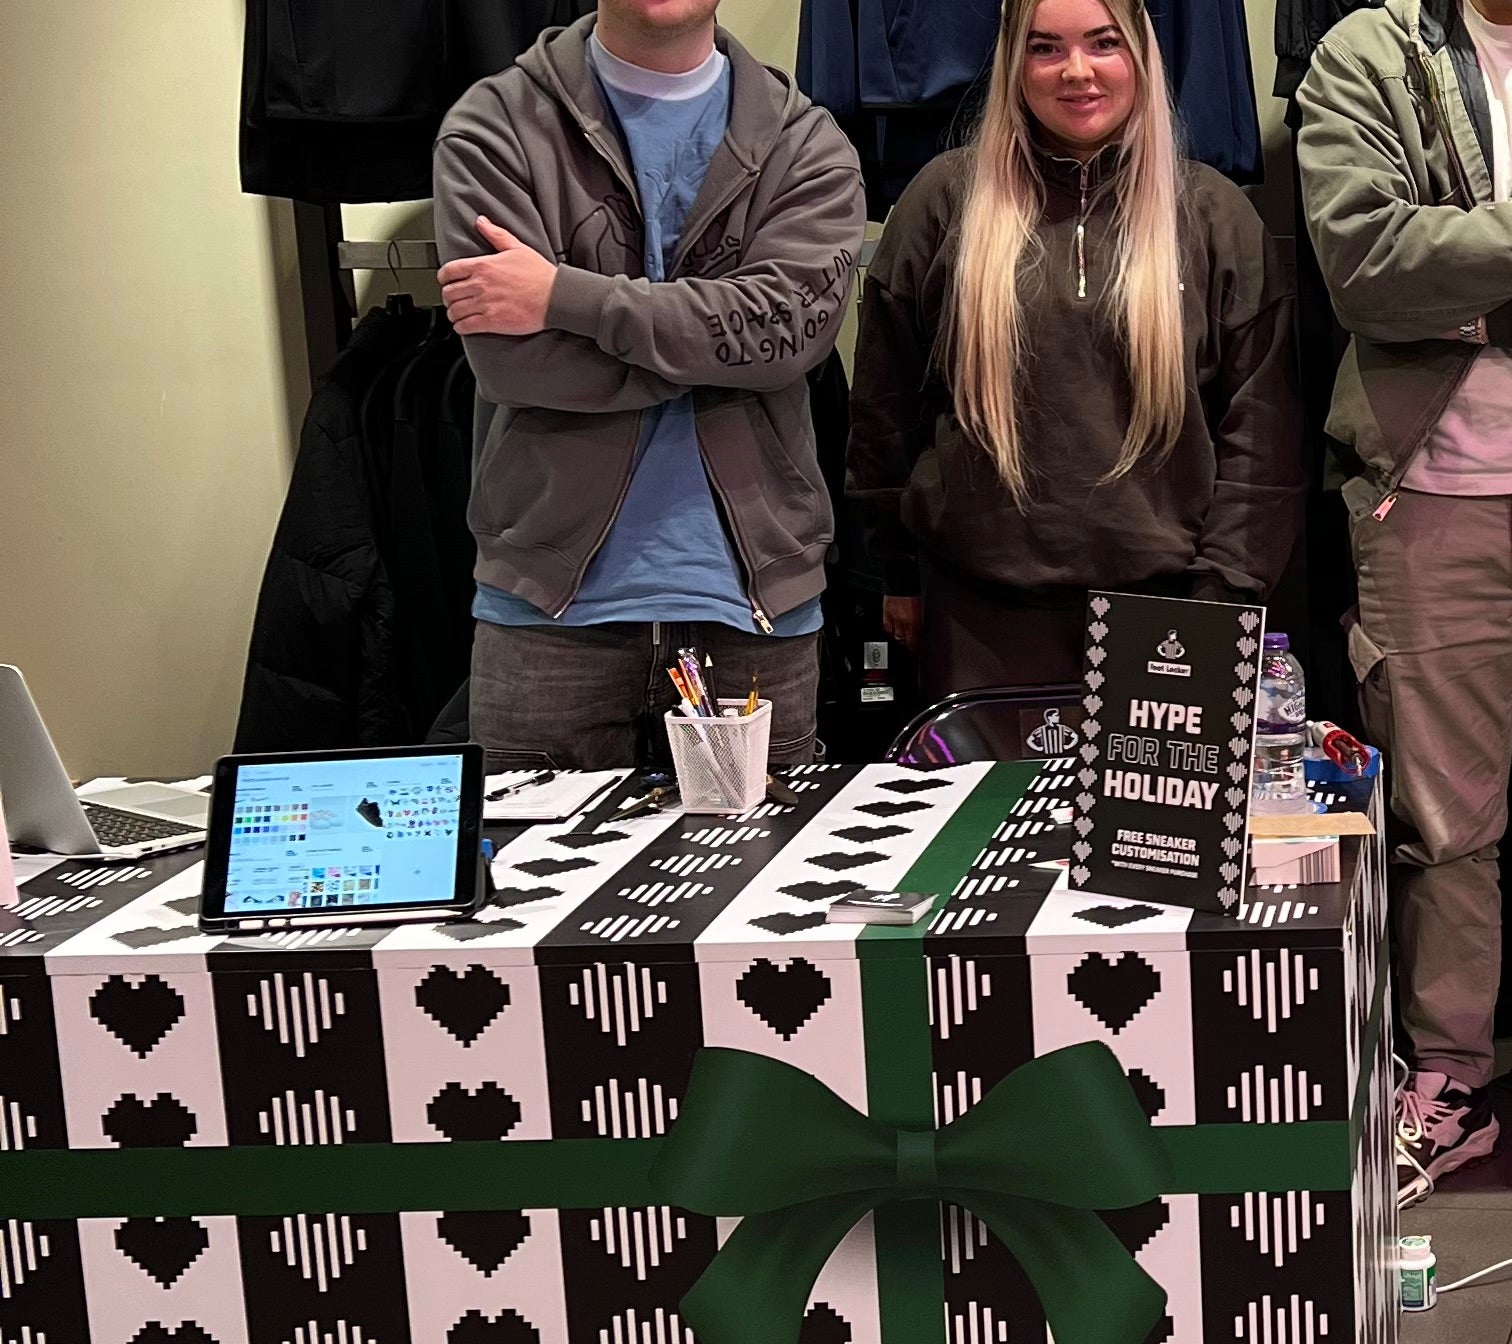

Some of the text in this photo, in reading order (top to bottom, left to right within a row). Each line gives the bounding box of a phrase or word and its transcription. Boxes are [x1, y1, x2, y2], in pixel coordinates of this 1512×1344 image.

[715, 341, 753, 367] TO
[1129, 699, 1203, 734] HYPE
[1107, 733, 1220, 774] FOR THE
[1103, 769, 1220, 810] HOLIDAY
[1111, 843, 1200, 867] CUSTOMISATION
[1116, 829, 1197, 852] FREE SNEAKER
